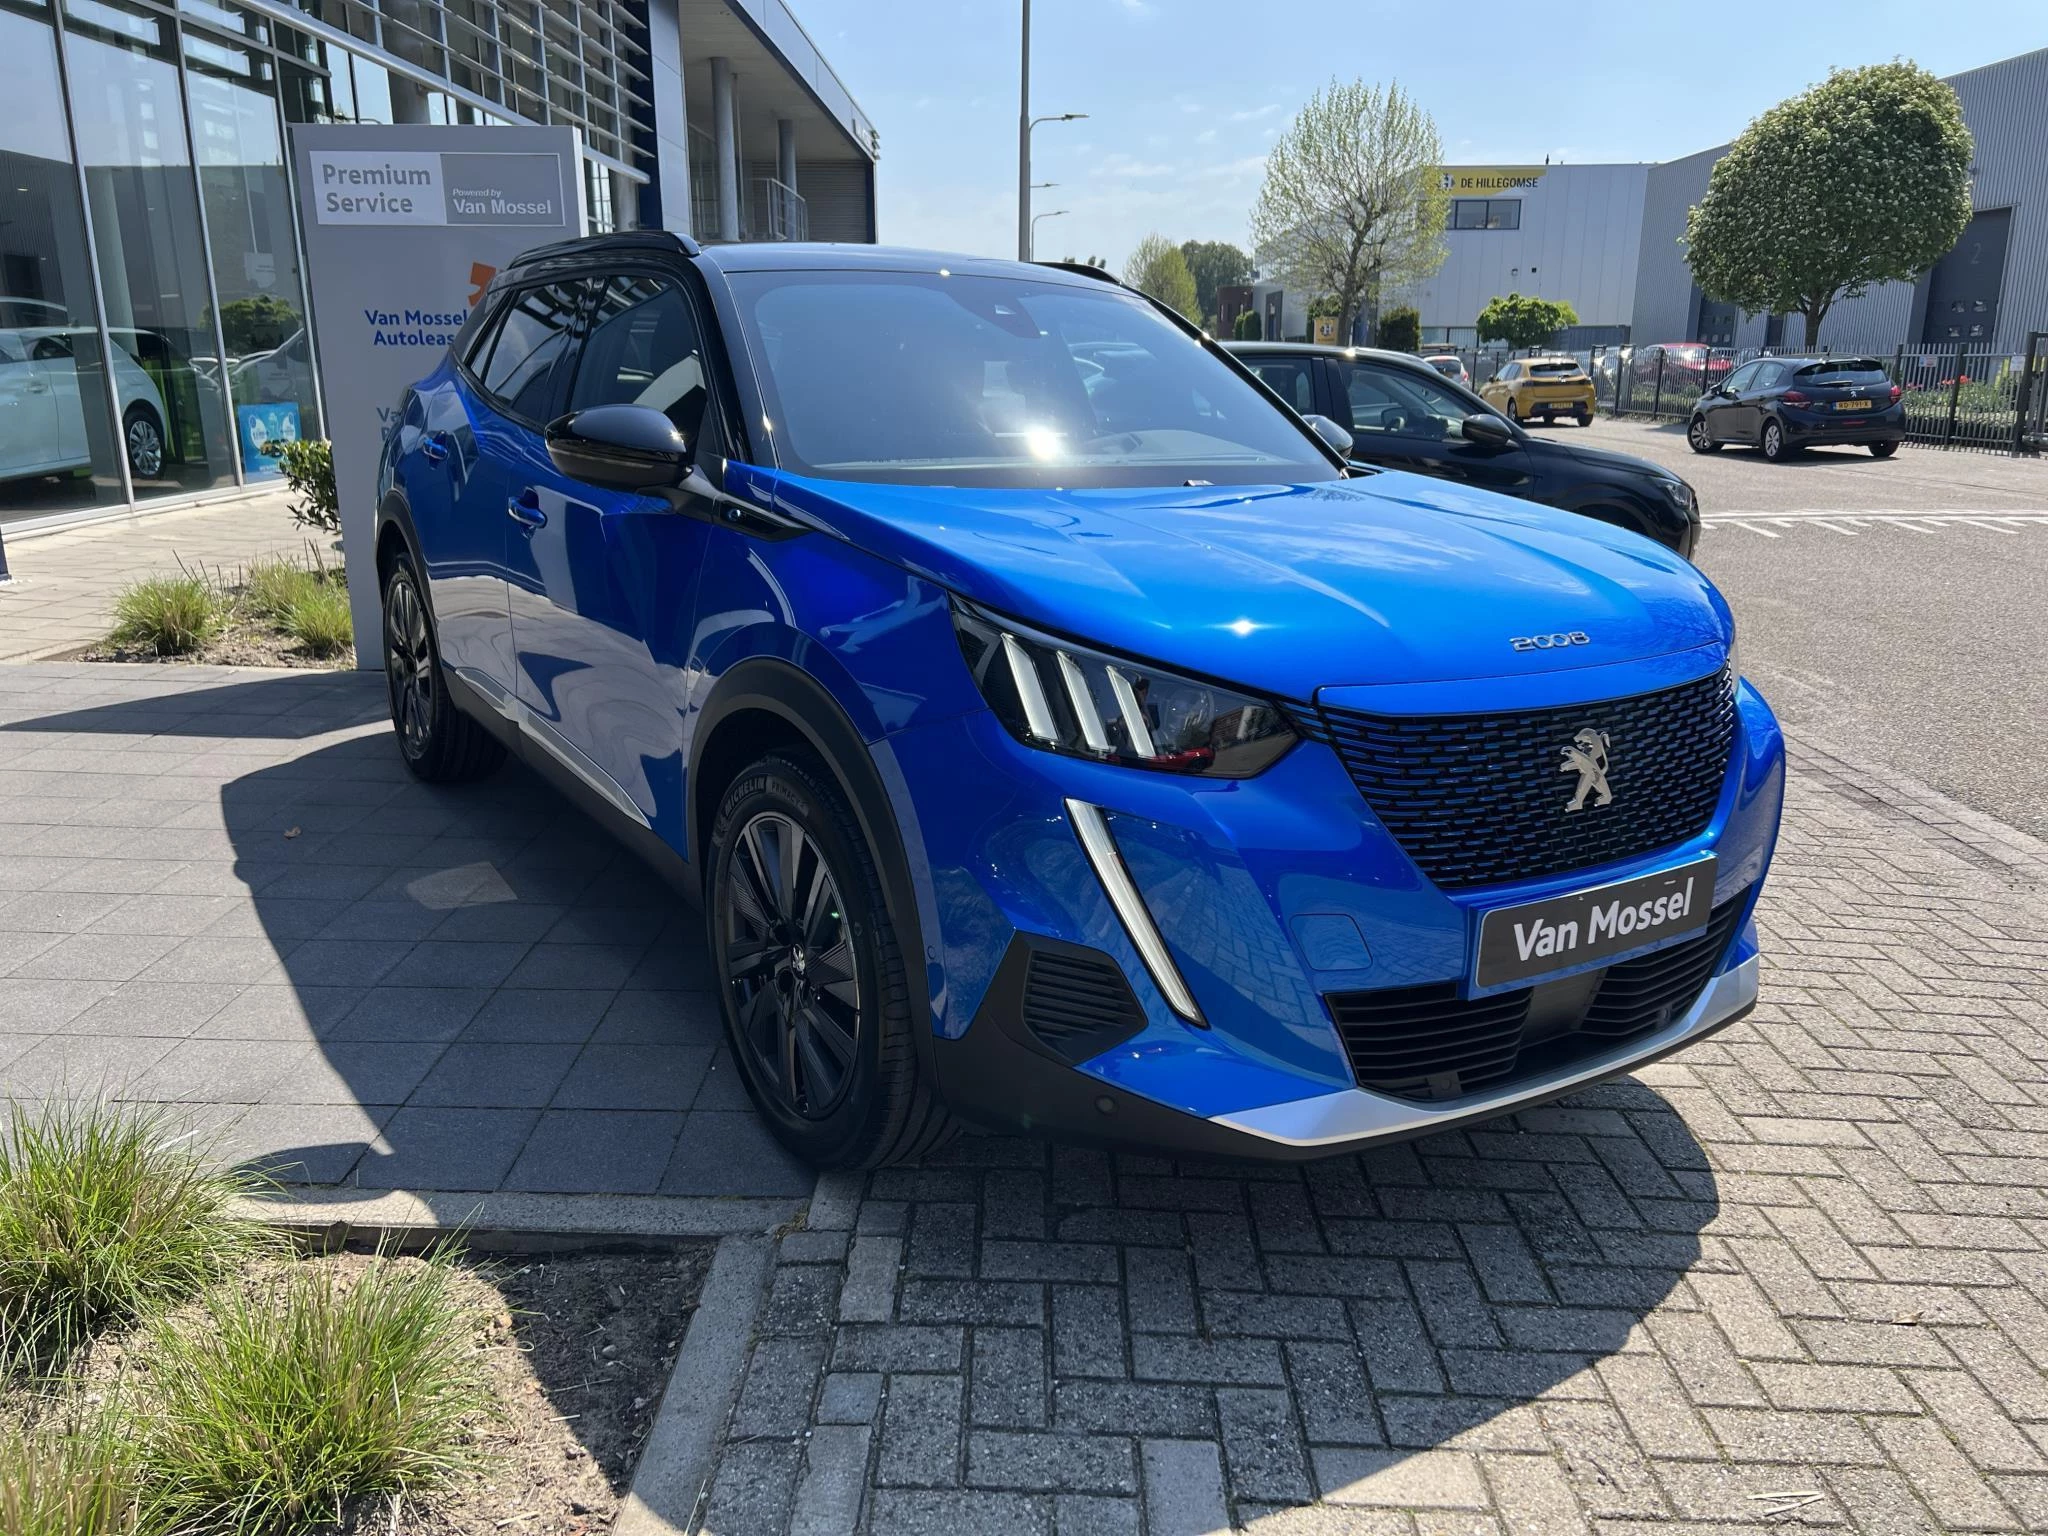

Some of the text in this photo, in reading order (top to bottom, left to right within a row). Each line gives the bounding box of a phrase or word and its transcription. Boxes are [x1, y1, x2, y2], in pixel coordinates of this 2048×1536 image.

[322, 163, 431, 185] Premium
[1460, 177, 1473, 188] DE
[1475, 177, 1539, 189] HILLEGOMSE
[326, 191, 413, 213] Service
[452, 188, 502, 198] Powered by
[453, 199, 552, 214] Van Mossel
[1970, 243, 1982, 264] 2
[364, 309, 468, 326] Van Mossel
[373, 329, 455, 346] Autoleas
[1509, 631, 1590, 651] 2008
[724, 776, 766, 817] MICHELIN
[1514, 877, 1695, 961] Van Mossel
